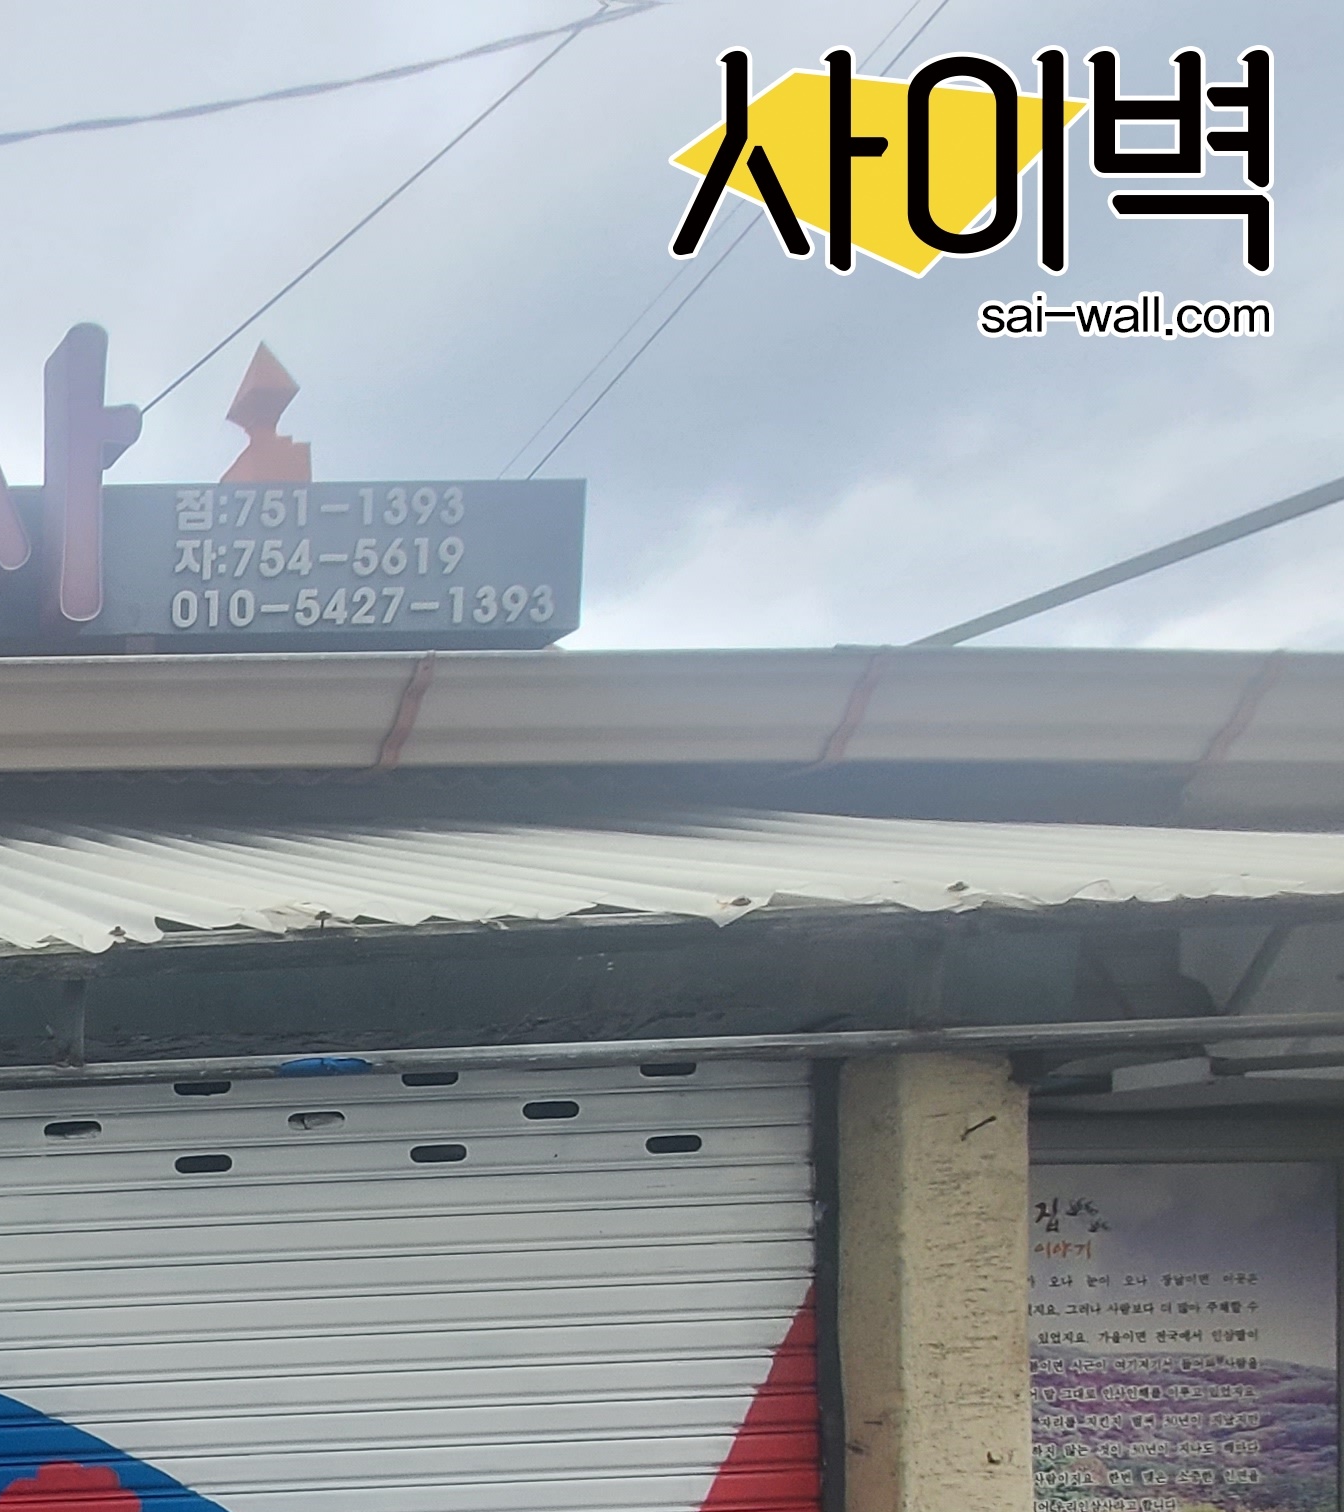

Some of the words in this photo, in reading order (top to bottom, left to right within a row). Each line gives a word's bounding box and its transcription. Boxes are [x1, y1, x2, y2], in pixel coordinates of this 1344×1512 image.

[171, 585, 555, 629] 010-5427-1393
[1035, 1198, 1059, 1233] 집
[1034, 1240, 1092, 1258] 이야기
